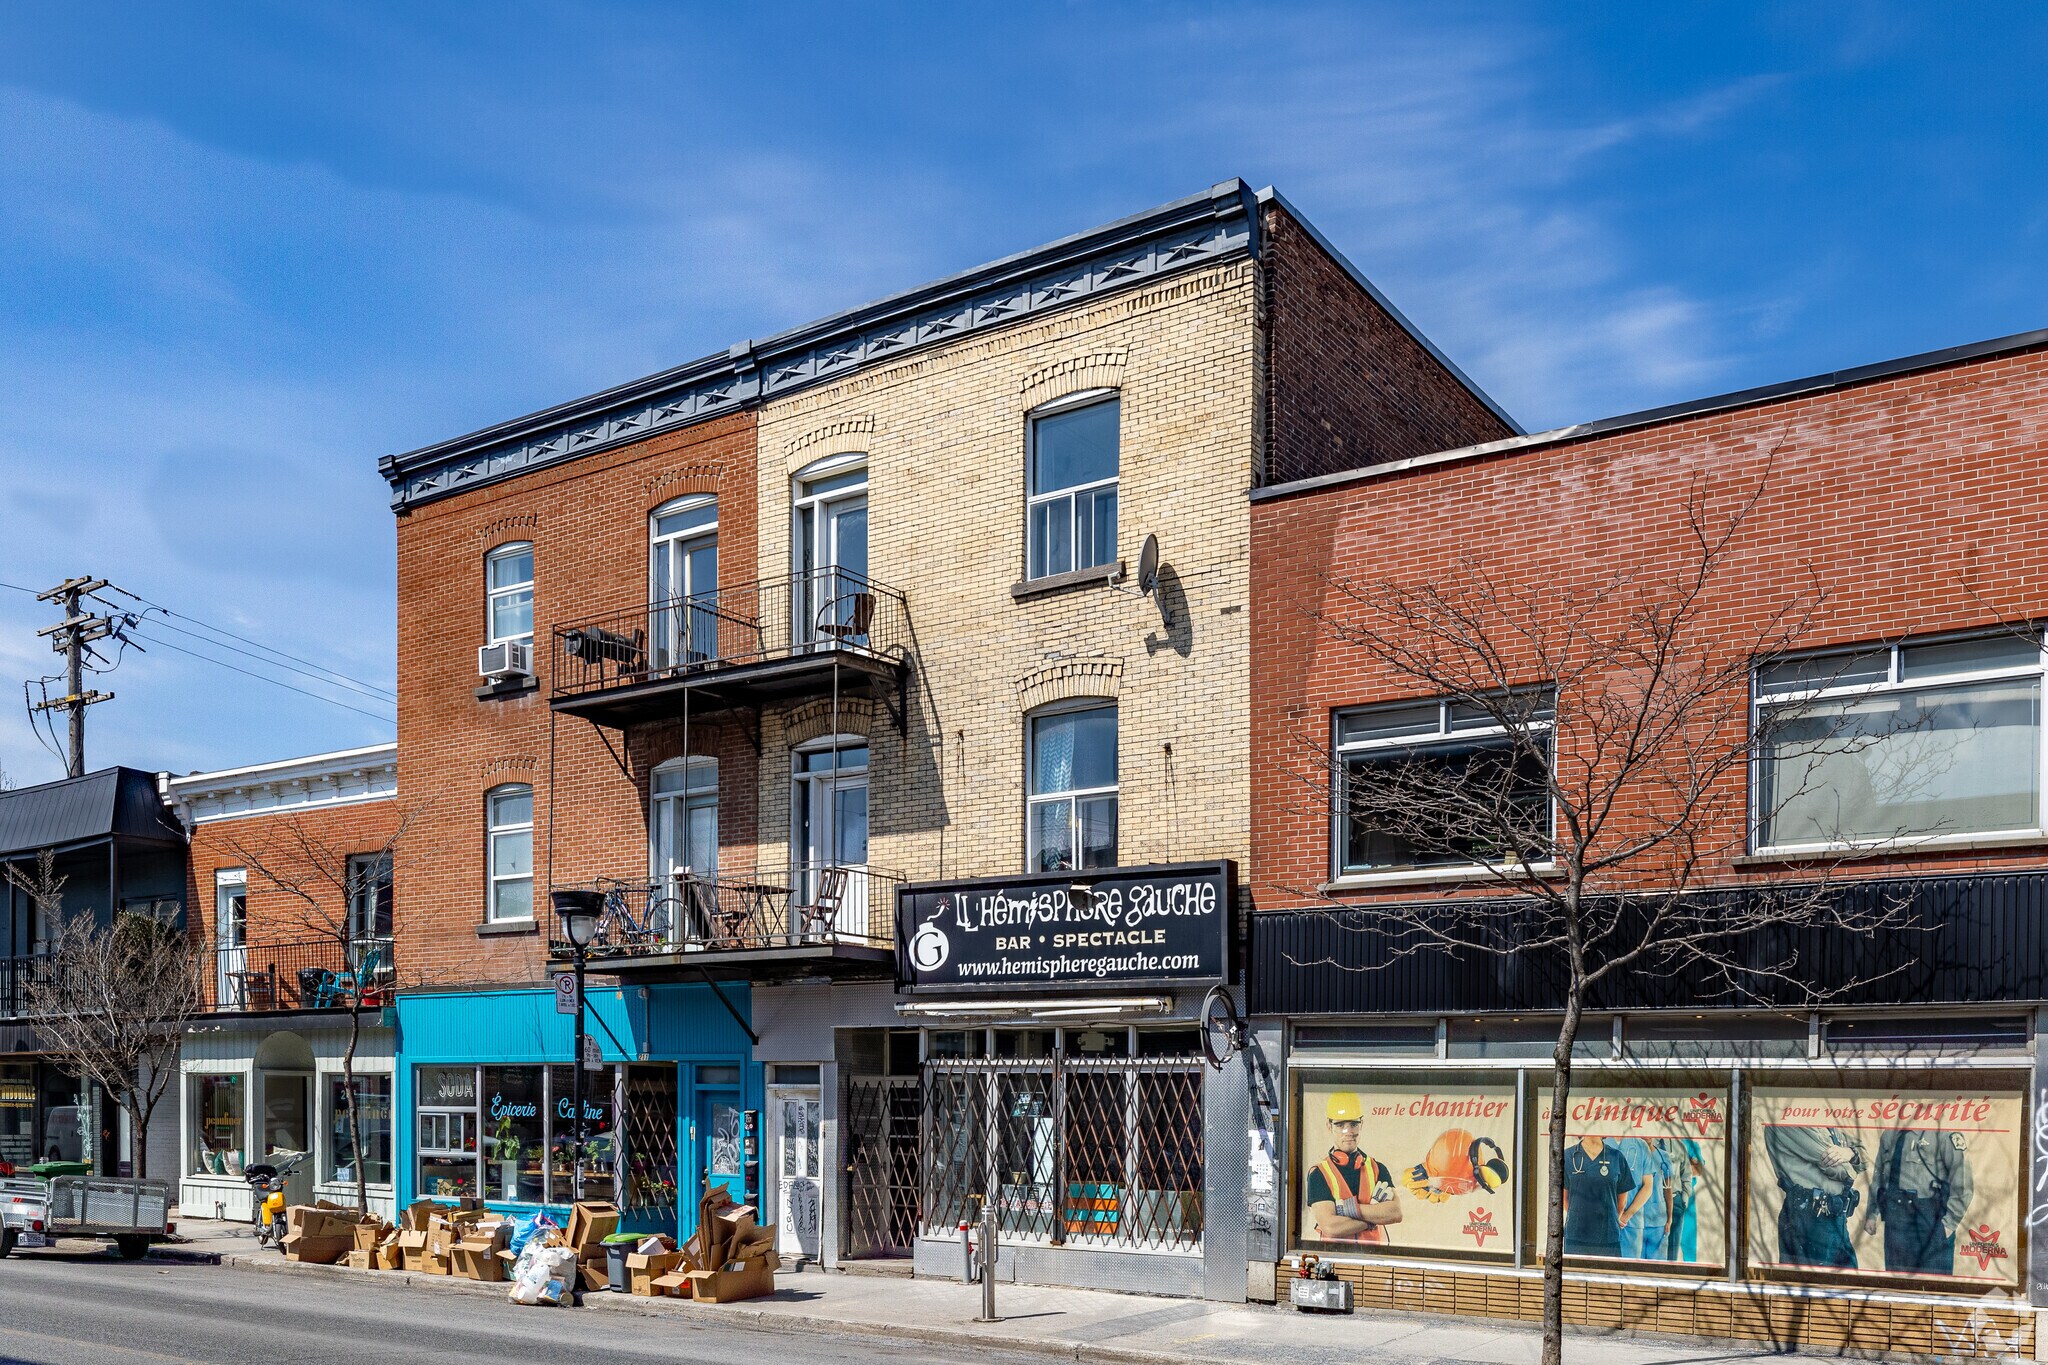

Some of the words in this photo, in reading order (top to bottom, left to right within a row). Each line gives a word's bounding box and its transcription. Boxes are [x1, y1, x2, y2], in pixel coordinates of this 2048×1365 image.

[995, 935, 1031, 951] BAR
[1053, 929, 1166, 949] SPECTACLE
[957, 951, 1200, 979] www.hemispheregauche.com
[438, 1073, 473, 1097] SODA
[491, 1092, 536, 1120] Épicerie
[557, 1097, 603, 1120] Catine
[1372, 1107, 1391, 1116] sur
[1395, 1103, 1405, 1116] le
[1409, 1094, 1508, 1117] chantier
[1542, 1107, 1550, 1120] à
[1572, 1097, 1678, 1128] clinique
[1683, 1112, 1722, 1120] MODERNA
[1782, 1106, 1820, 1121] pour
[1825, 1105, 1864, 1119] votre
[1868, 1094, 1991, 1122] sécurité
[1960, 1245, 2007, 1255] MODERNA
